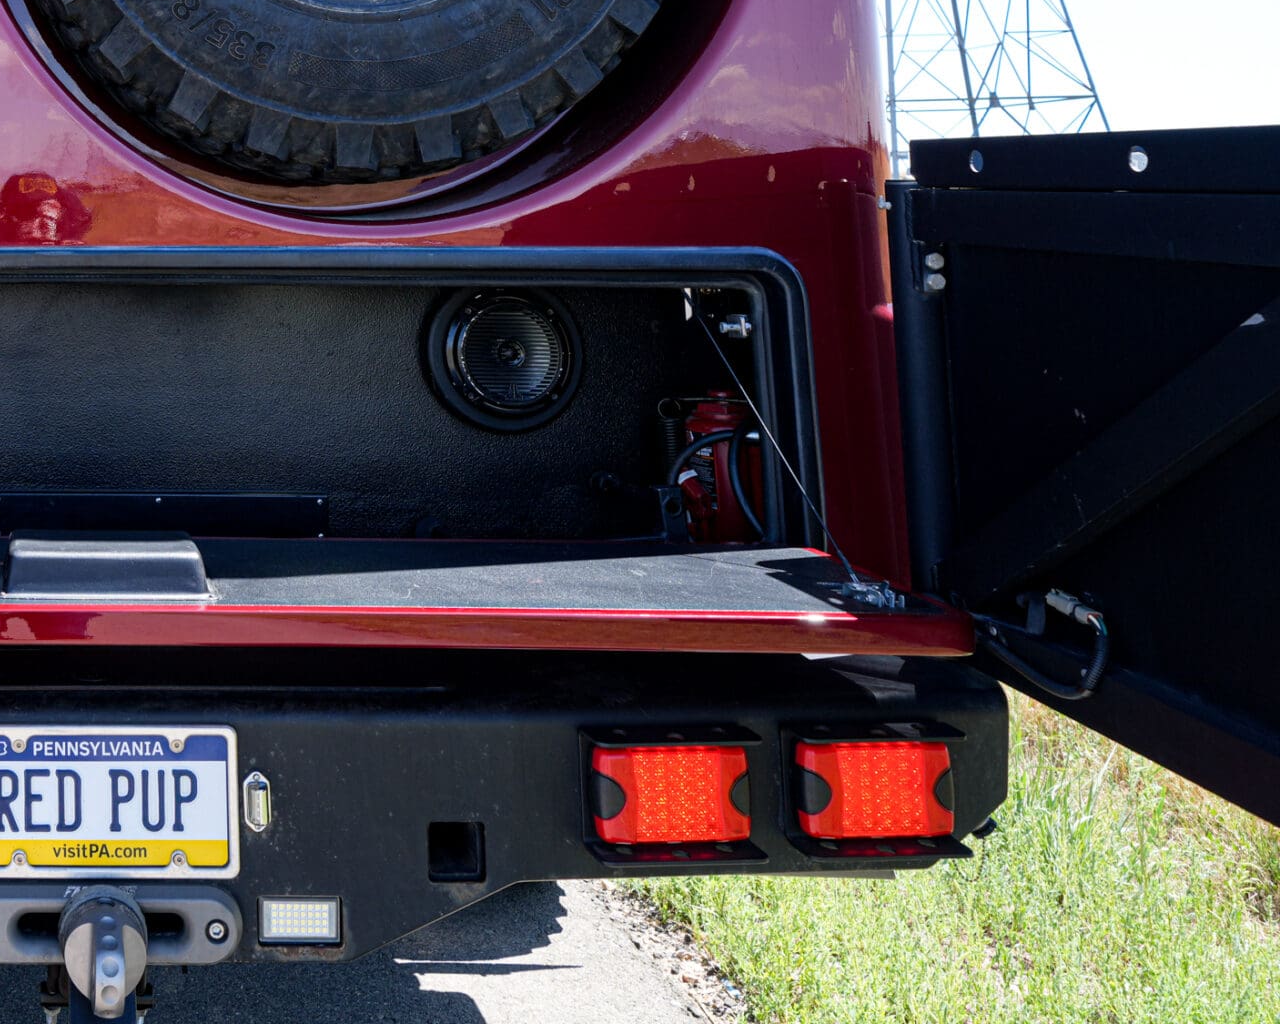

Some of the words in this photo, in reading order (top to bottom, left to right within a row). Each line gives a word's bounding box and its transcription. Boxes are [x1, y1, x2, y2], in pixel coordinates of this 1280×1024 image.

[33, 740, 164, 756] PENNSYLVANIA
[108, 768, 198, 833] PUP
[53, 843, 147, 859] visitPA.com
